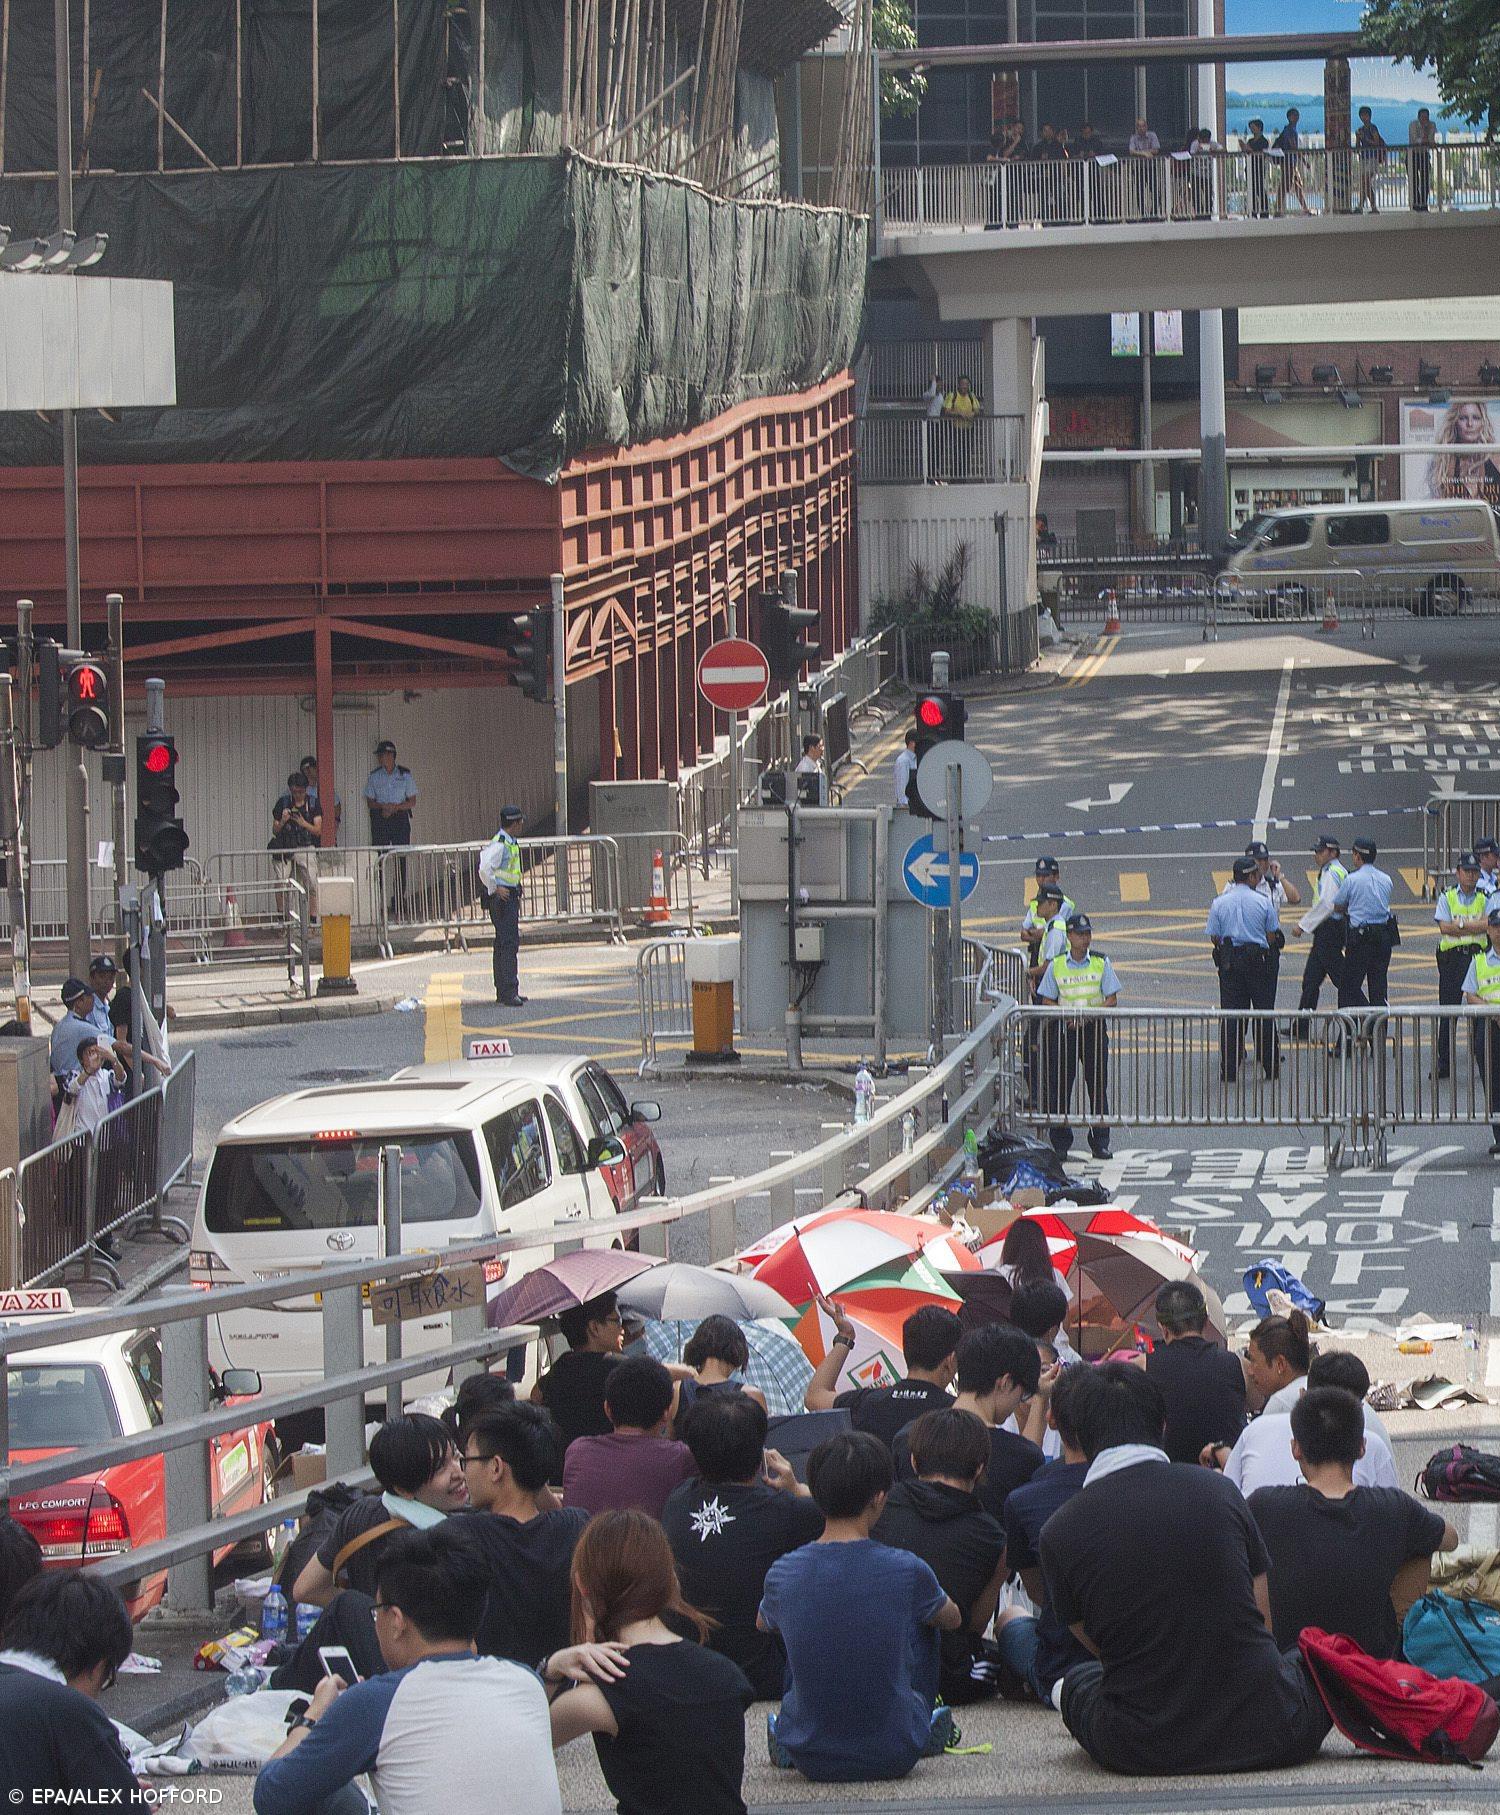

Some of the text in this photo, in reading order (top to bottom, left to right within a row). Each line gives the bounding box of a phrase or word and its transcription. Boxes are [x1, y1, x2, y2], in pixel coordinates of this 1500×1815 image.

[470, 1042, 511, 1057] TAXI
[0, 1292, 62, 1311] AXI
[41, 1497, 88, 1509] COMFORT
